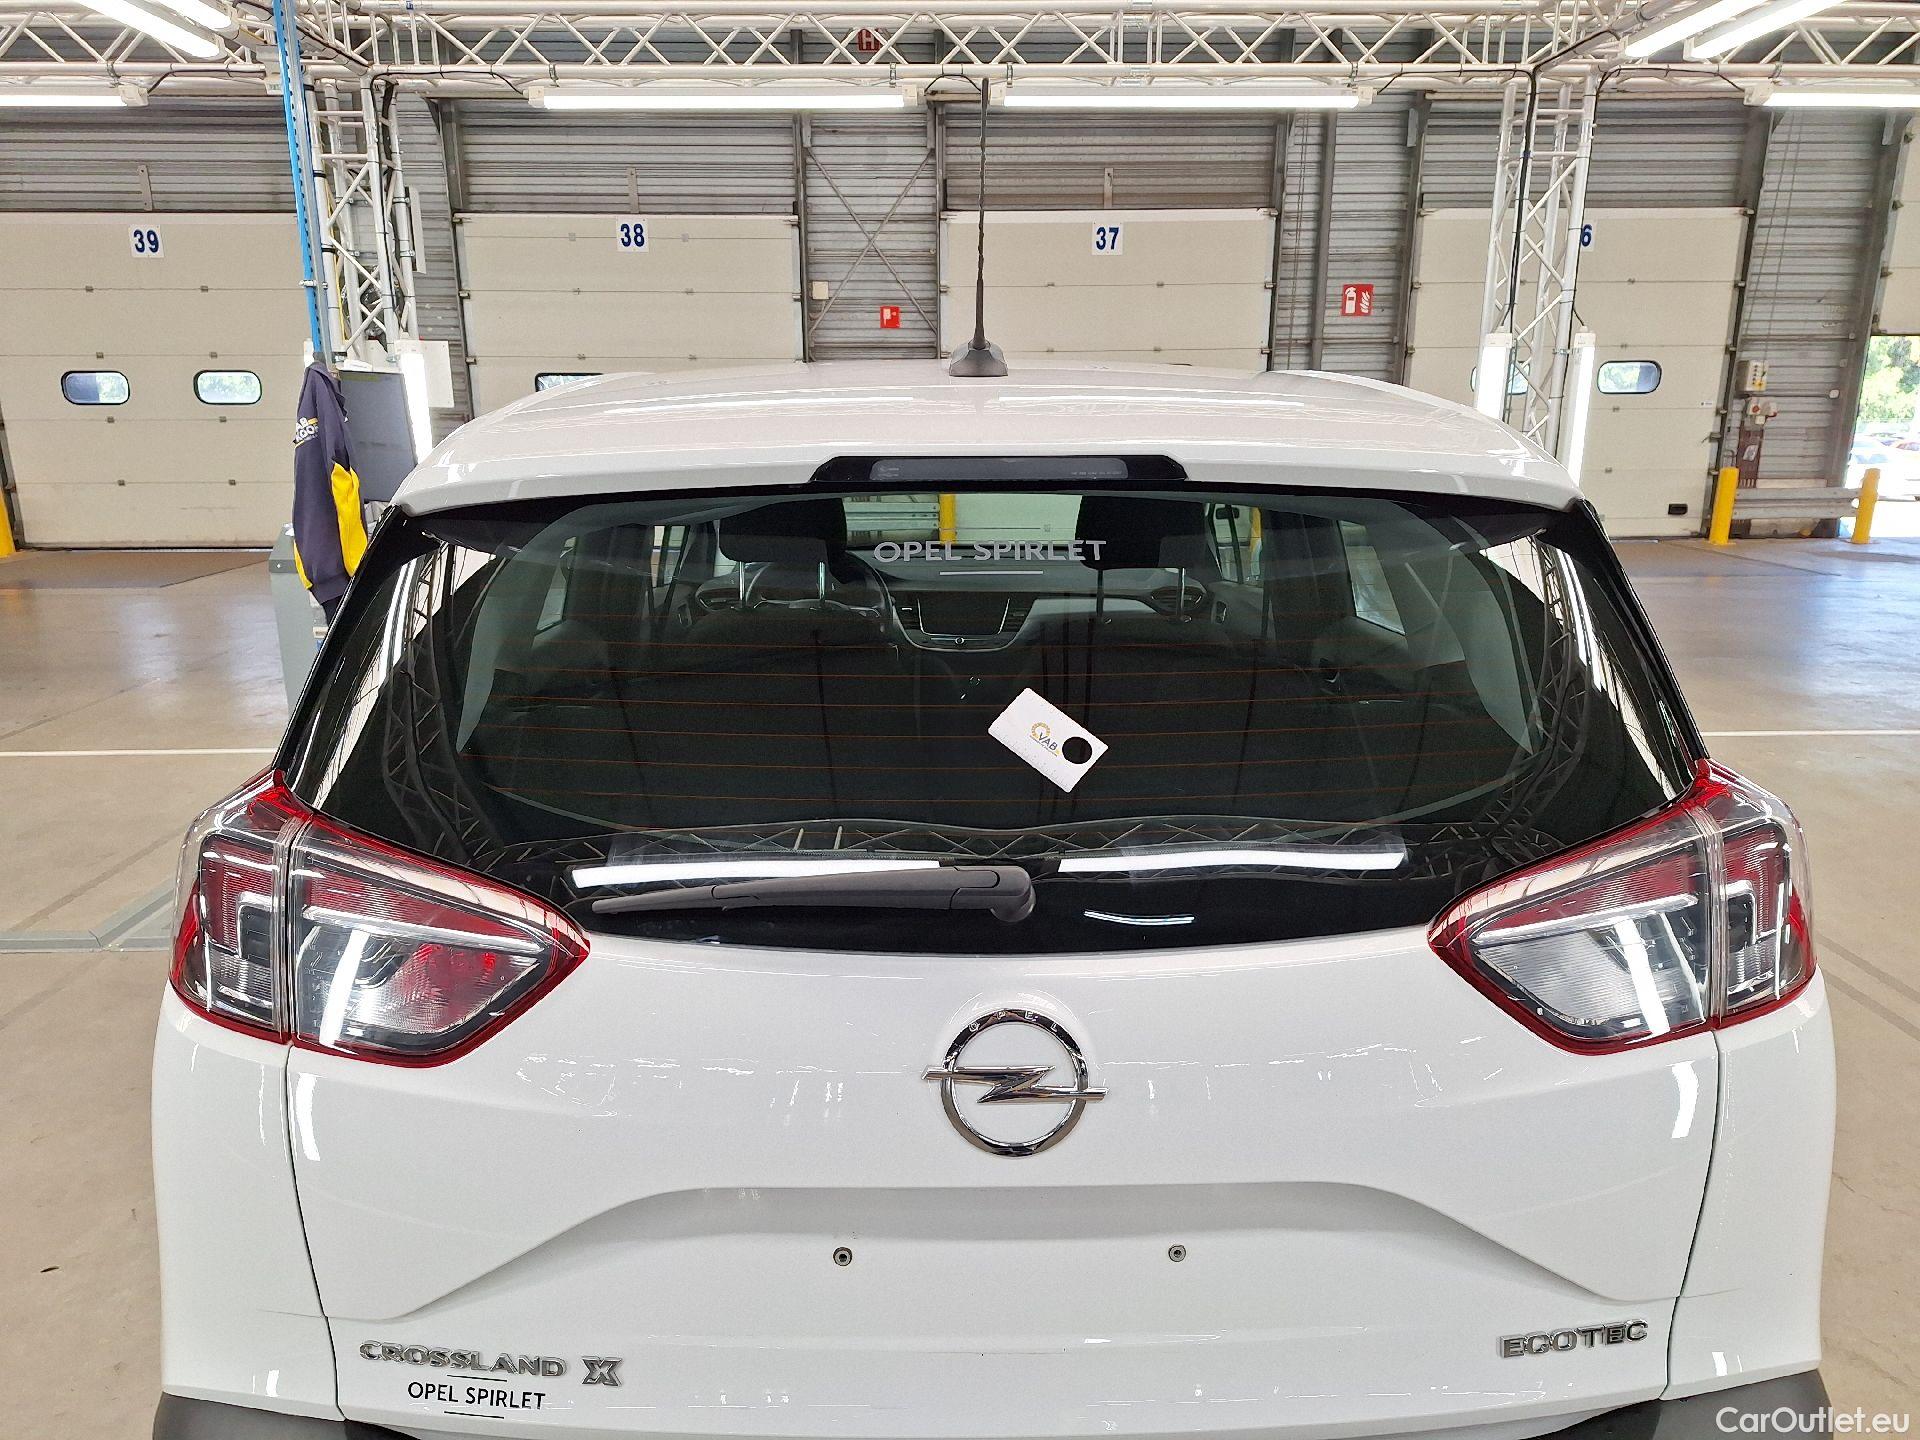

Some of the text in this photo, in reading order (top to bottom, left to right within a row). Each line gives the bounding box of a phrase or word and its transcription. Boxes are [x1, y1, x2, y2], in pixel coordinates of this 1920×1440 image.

[133, 229, 159, 253] 39
[620, 223, 645, 247] 38
[1096, 226, 1119, 250] 37
[1581, 224, 1593, 247] 6
[874, 539, 1107, 563] OPEL SPIRLET
[1038, 732, 1058, 751] VAB
[968, 1009, 1058, 1033] OPEL
[1496, 1318, 1648, 1359] ECOTEC
[359, 1340, 623, 1386] CROSSLAND X
[407, 1381, 546, 1410] OPEL SPIRLET
